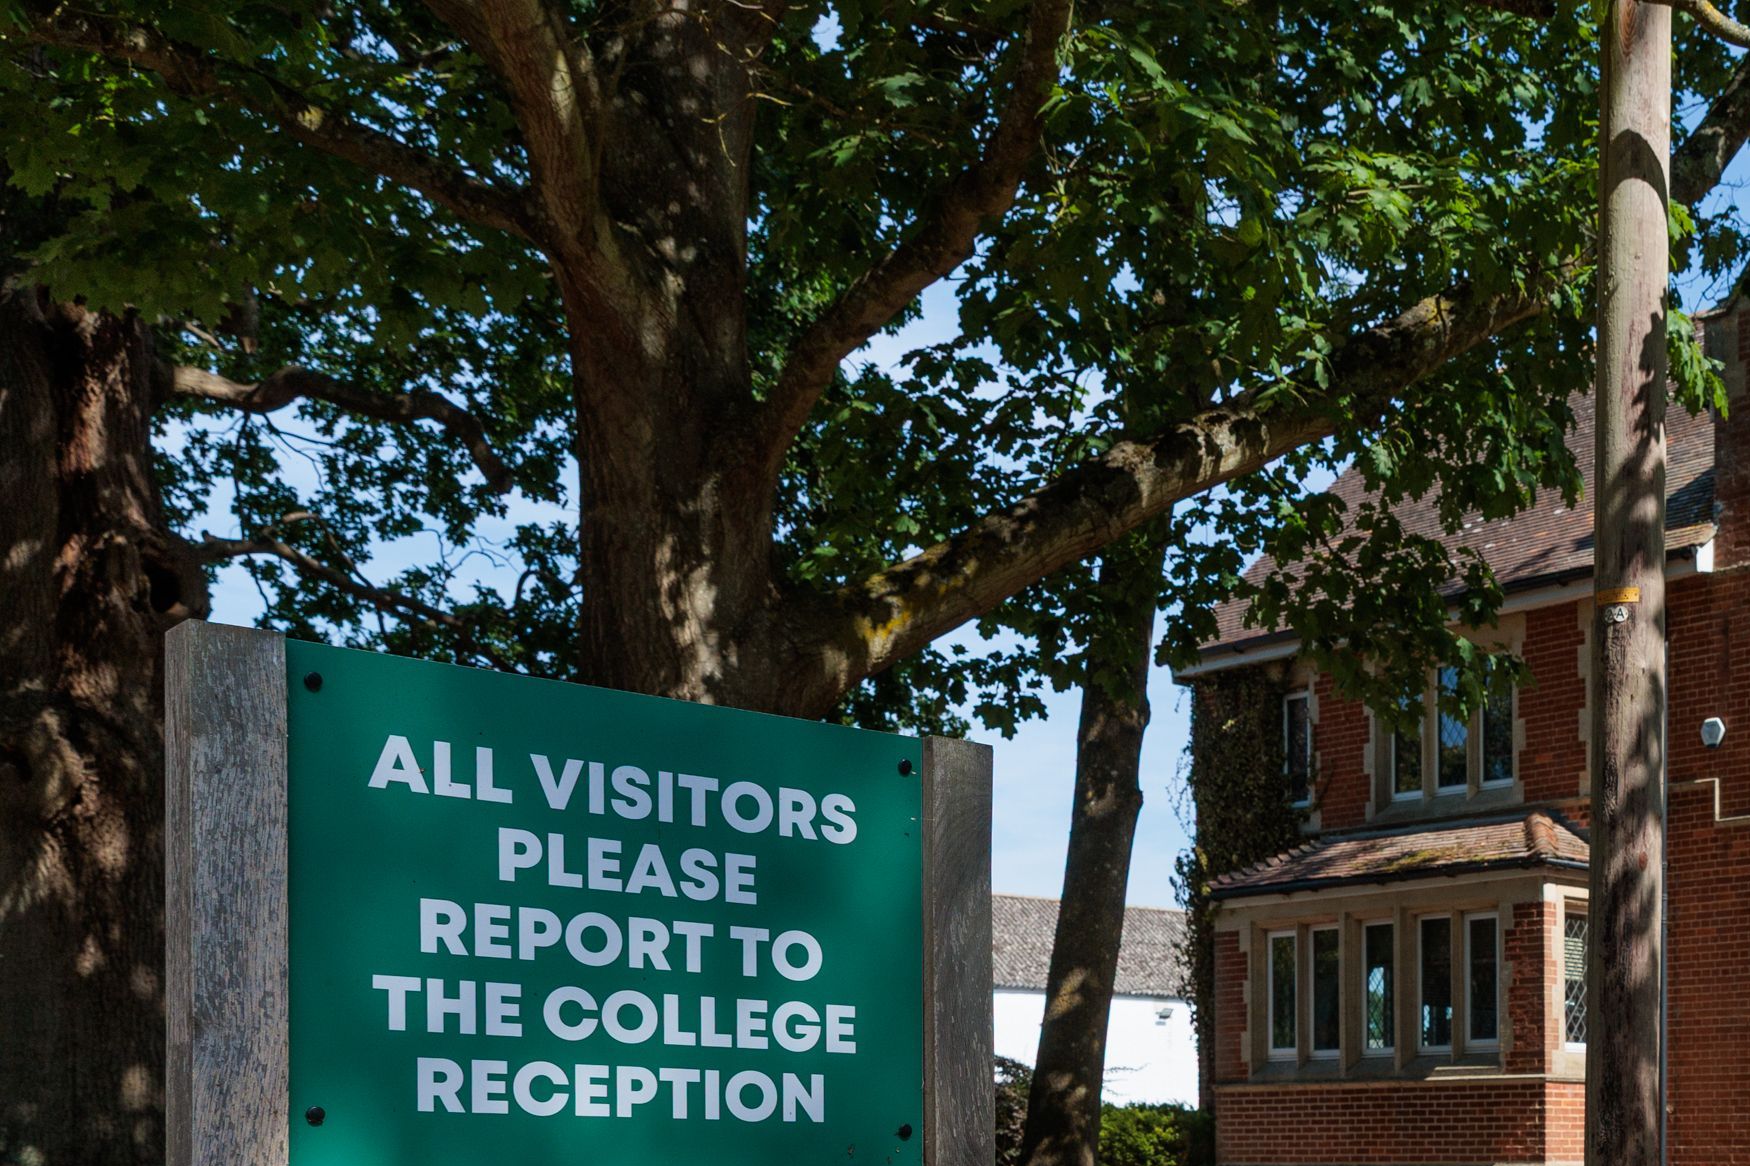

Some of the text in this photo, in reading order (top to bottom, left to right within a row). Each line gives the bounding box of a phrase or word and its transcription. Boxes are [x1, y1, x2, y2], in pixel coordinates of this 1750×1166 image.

[367, 734, 858, 845] ALL VISITORS
[498, 827, 757, 905] PLEASE
[420, 898, 823, 982] REPORT TO
[372, 974, 857, 1054] THE COLLEGE
[417, 1057, 825, 1123] RECEPTION
